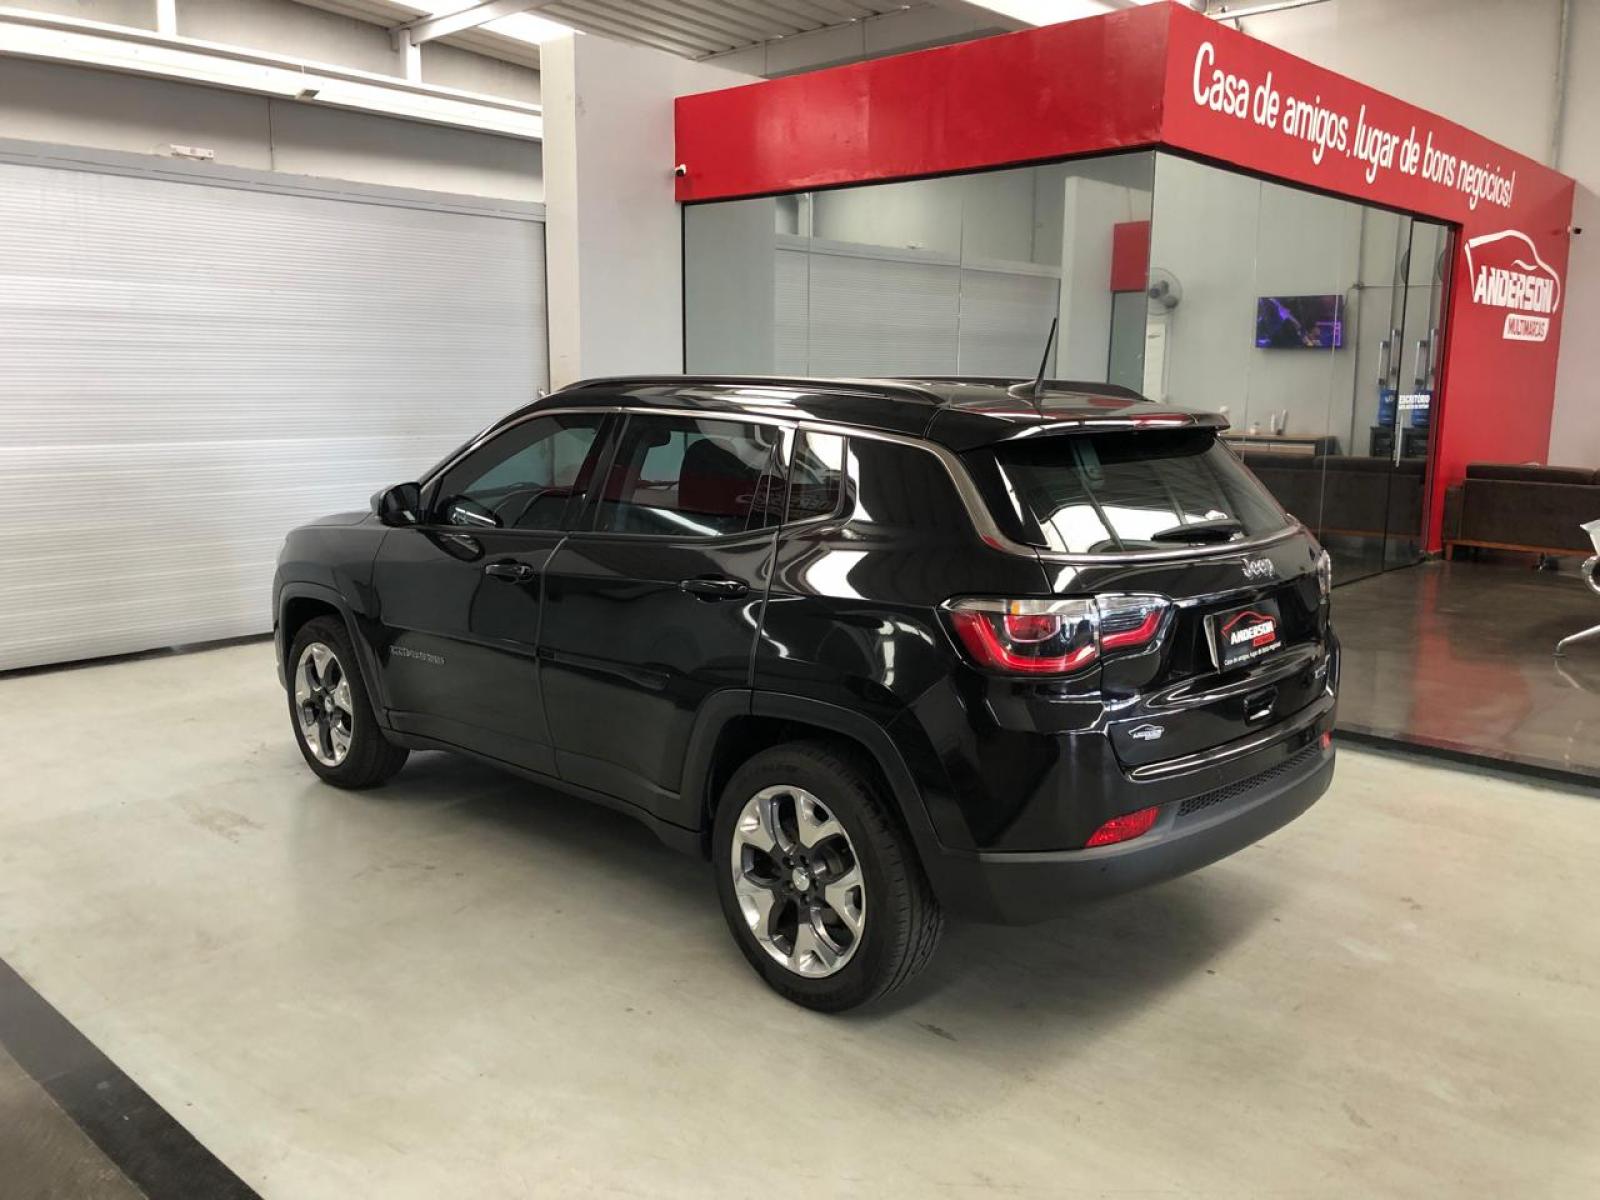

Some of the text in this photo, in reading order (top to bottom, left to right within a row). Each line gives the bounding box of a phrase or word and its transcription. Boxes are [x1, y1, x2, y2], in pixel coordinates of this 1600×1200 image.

[1193, 41, 1516, 210] Casa de amigos, lugar de bons negócios!
[1474, 265, 1554, 313] ANDERSON
[1241, 558, 1275, 579] Jeep
[1230, 620, 1274, 646] ANDERSON
